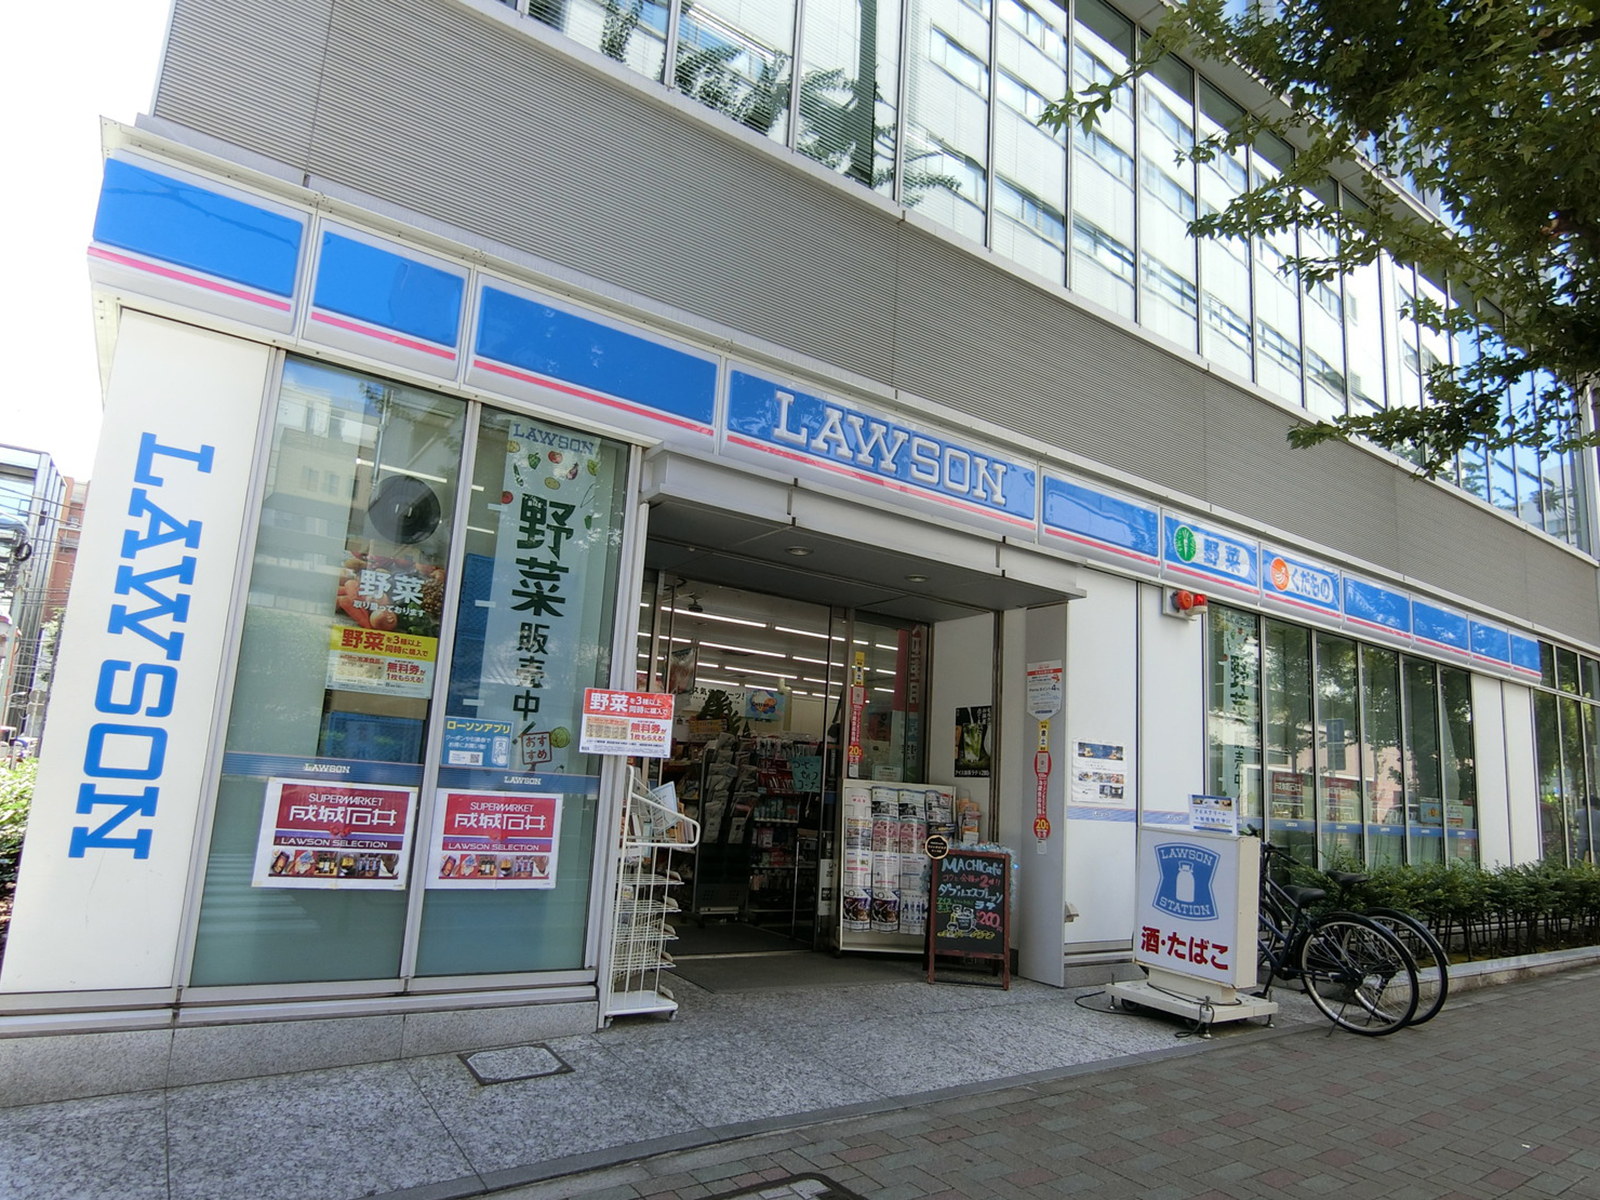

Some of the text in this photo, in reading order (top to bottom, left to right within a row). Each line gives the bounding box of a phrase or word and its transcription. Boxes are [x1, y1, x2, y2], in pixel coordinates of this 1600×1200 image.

[512, 423, 595, 455] LAWSON
[773, 390, 1007, 506] LAWSON
[1203, 539, 1242, 573] 野菜
[358, 569, 425, 605] 野菜
[1290, 568, 1331, 600] くだもの
[353, 600, 426, 617] 取り扱っております
[68, 432, 215, 859] LAWSON
[341, 629, 386, 651] 野菜
[590, 692, 629, 712] 野菜
[447, 720, 511, 734] ローソンアプリ
[304, 763, 351, 774] LAWSON
[504, 776, 541, 785] LAWSON
[308, 793, 384, 807] SUPERMARKET
[470, 801, 534, 813] SUPERMARKET
[289, 805, 397, 827] 成城石井
[455, 813, 546, 831] 成城石井
[281, 837, 388, 849] LAWSON SELECTION
[448, 842, 539, 851] LAWSON SELECTION
[1160, 848, 1213, 866] LAWSON
[938, 883, 1003, 903] ダブルエスプレッソ
[974, 900, 996, 910] ラテ
[1159, 896, 1211, 916] STATION
[1140, 926, 1229, 970] 酒・たばこ
